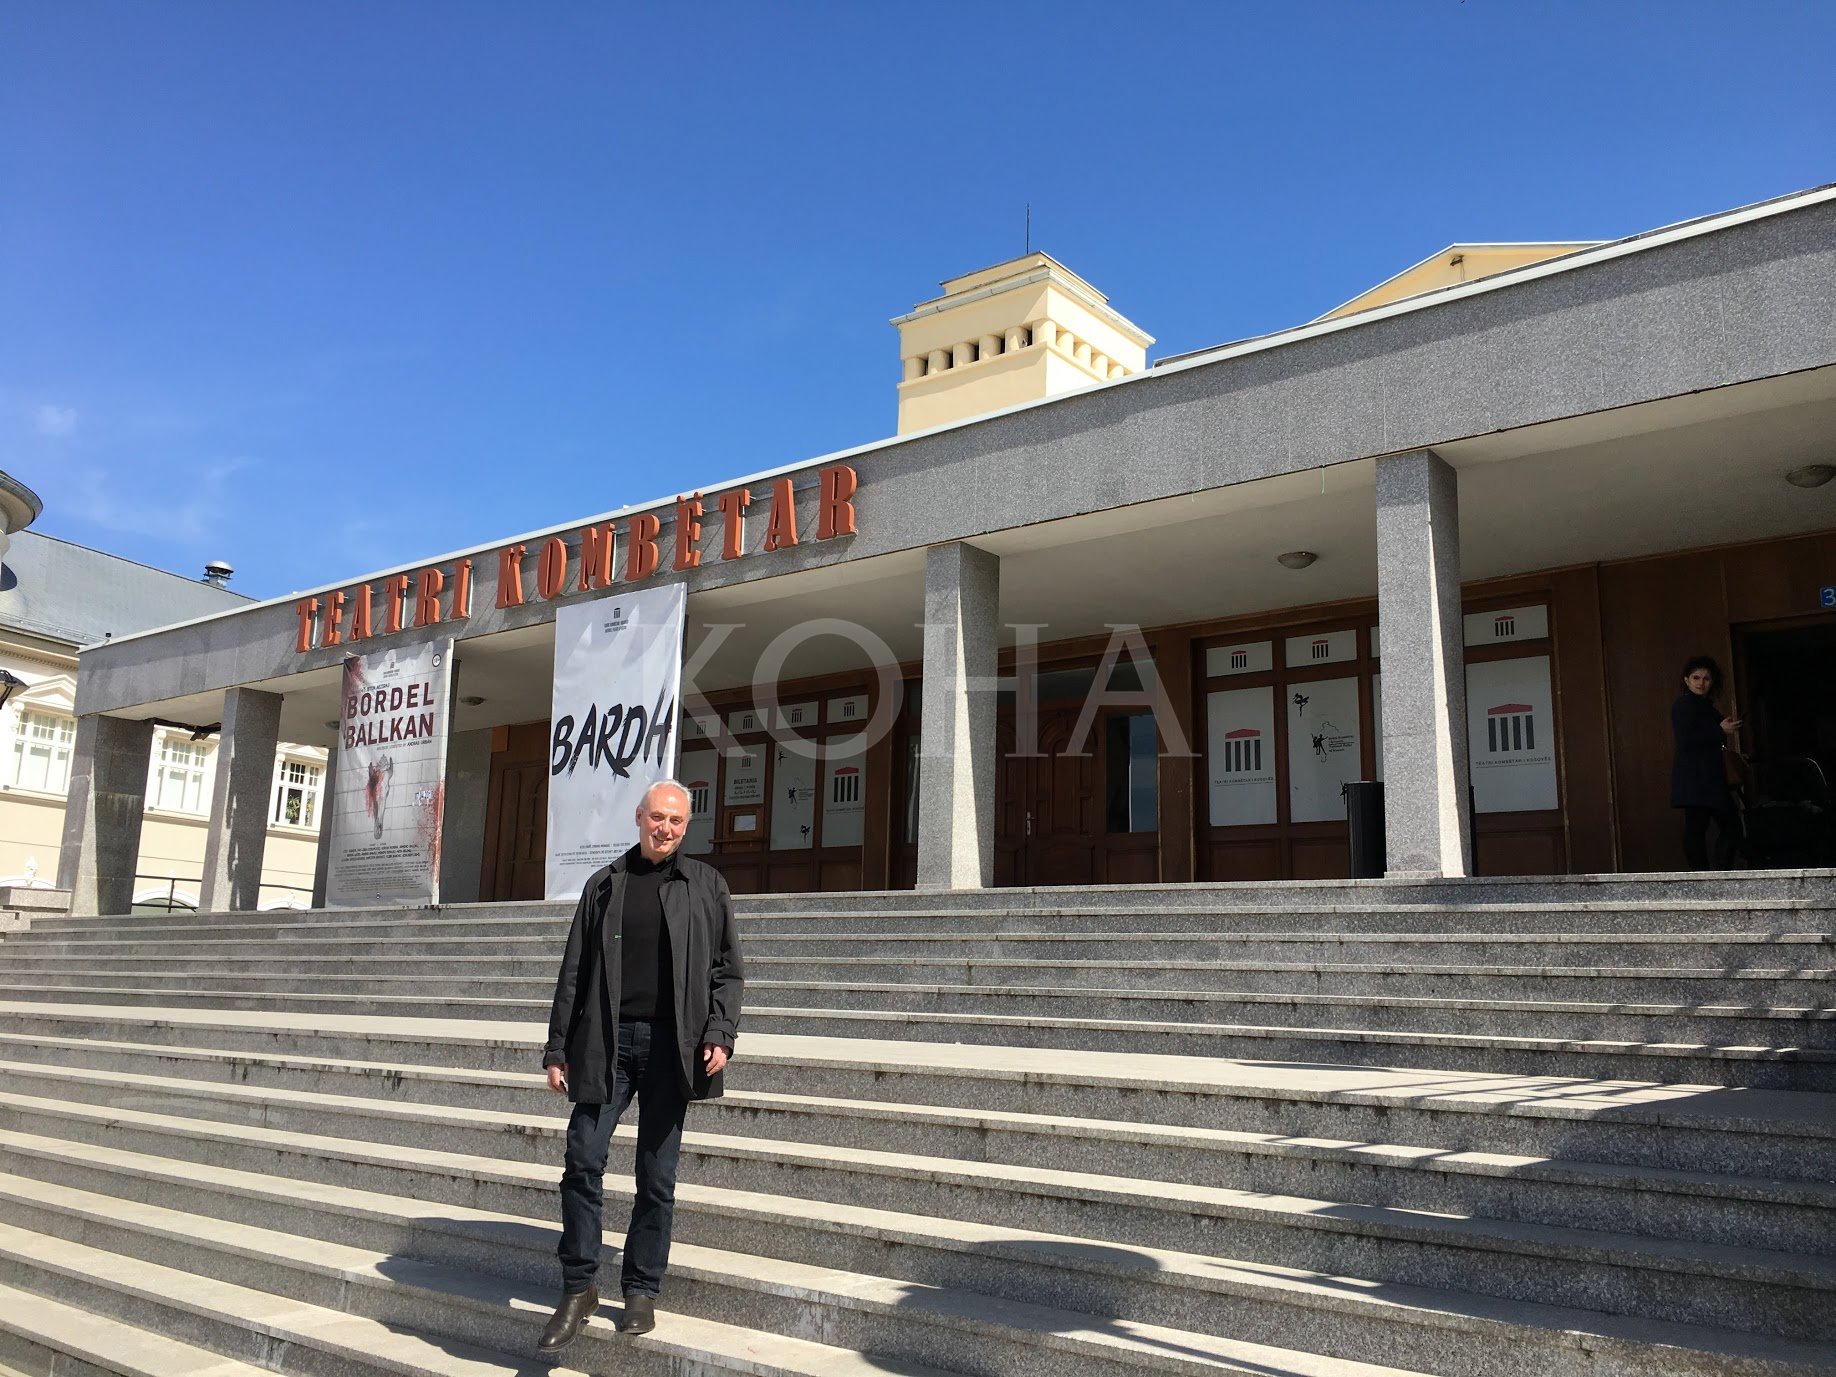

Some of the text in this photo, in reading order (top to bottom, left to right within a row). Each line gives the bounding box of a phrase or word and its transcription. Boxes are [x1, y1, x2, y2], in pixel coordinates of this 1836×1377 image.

[295, 464, 858, 653] TEATRI KOMBËTAR
[347, 682, 434, 719] BORDEL
[345, 712, 434, 749] BALLKAN
